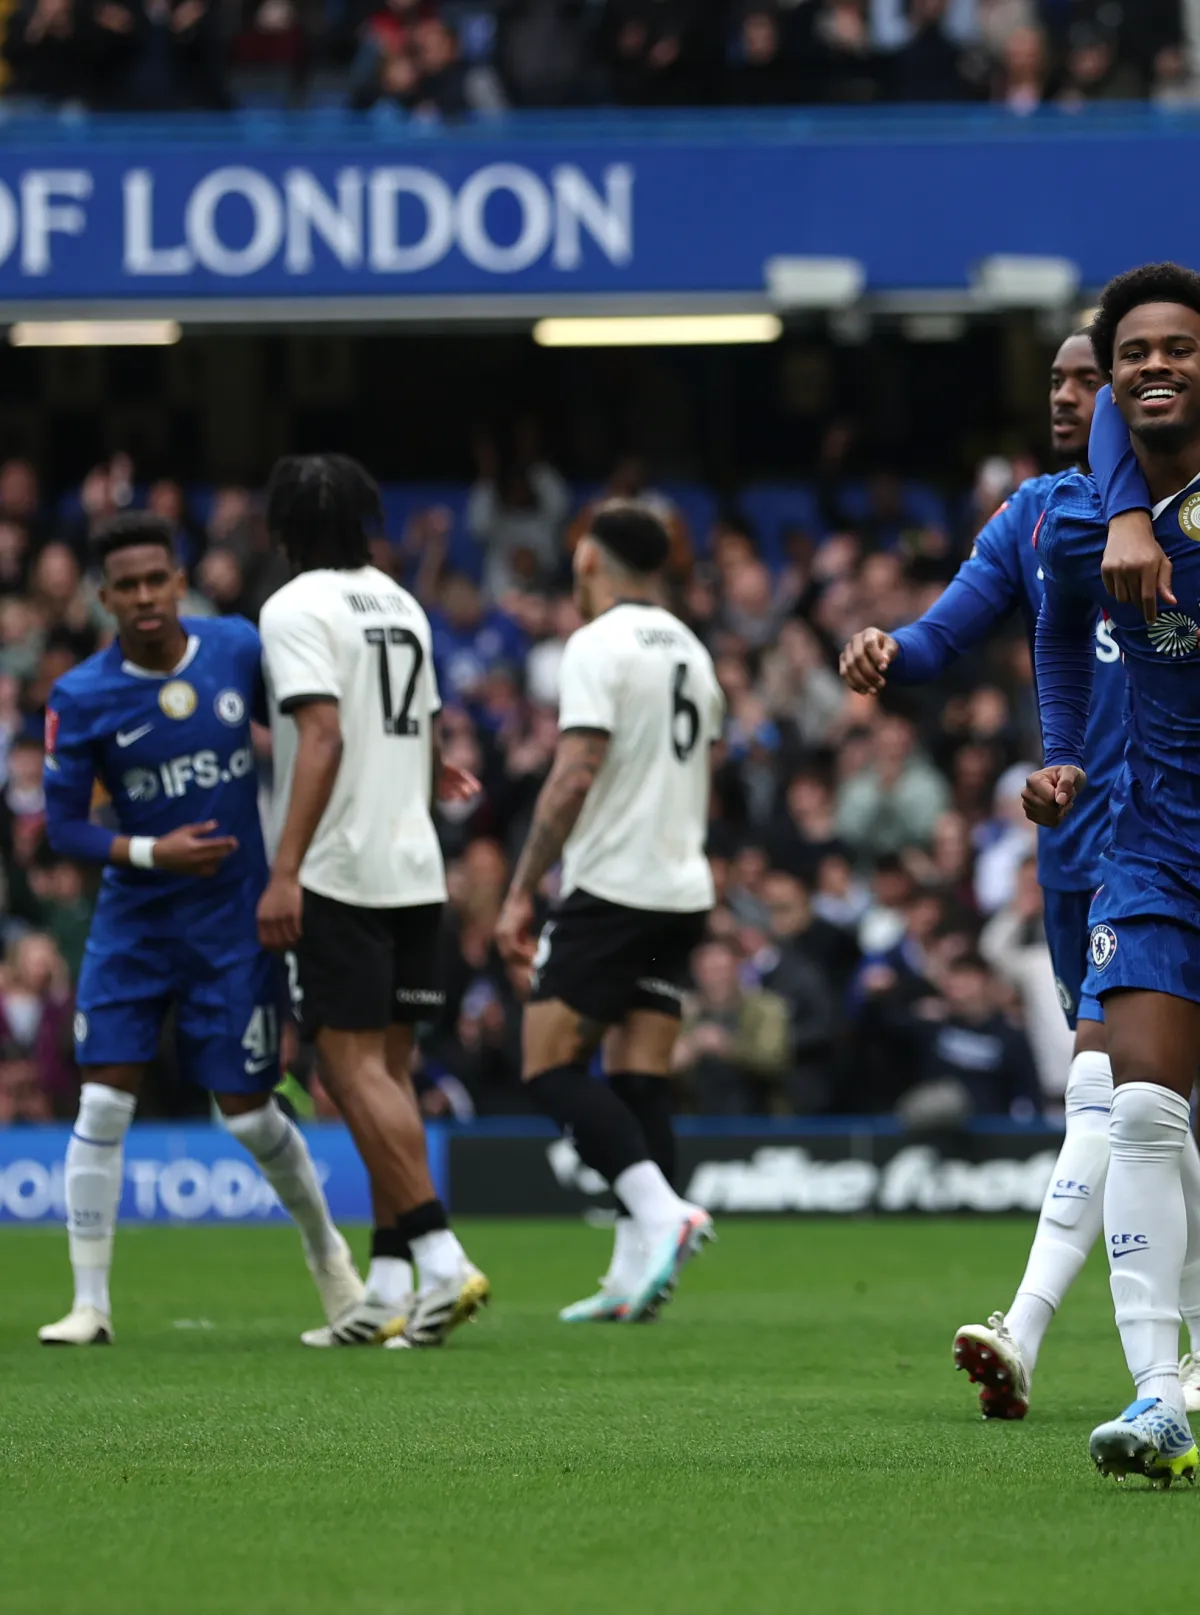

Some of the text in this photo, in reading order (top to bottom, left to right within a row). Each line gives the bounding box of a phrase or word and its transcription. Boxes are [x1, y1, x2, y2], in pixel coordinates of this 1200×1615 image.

[0, 160, 635, 277] F LONDON
[1182, 506, 1192, 531] WORLD
[364, 627, 423, 736] 12
[672, 663, 700, 763] 6
[1056, 1179, 1090, 1196] CFC
[1111, 1233, 1148, 1245] CFC
